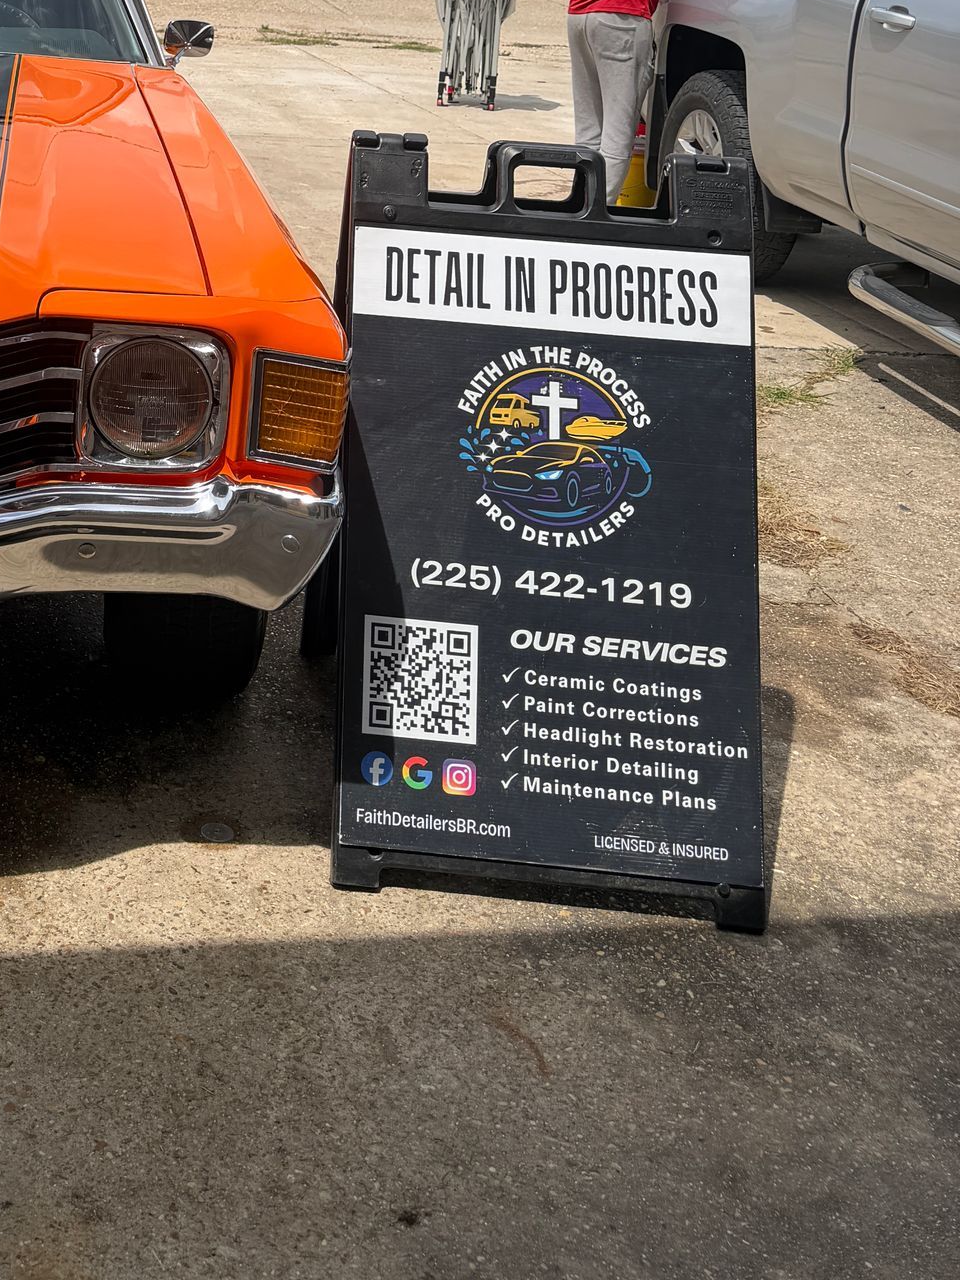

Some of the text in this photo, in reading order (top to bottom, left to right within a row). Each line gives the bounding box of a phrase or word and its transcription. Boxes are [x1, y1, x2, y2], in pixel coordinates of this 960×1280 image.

[385, 246, 718, 328] DETAIL IN PROGRESS
[458, 345, 651, 428] FAITH IN THE PROCESS
[475, 493, 635, 548] PRO DETAILERS
[411, 558, 692, 609] (225) 422-1219
[510, 629, 727, 667] OUR SERVICES
[524, 669, 702, 703] Ceramic Coatings
[524, 695, 699, 728] Paint Corrections
[523, 722, 748, 759] Headlight Restoration
[523, 748, 699, 785] Interior Detailing
[523, 775, 717, 811] Maintenance Plans
[356, 808, 511, 838] FaithDetailersBR.com
[594, 835, 729, 861] LICENSED & INSURED
